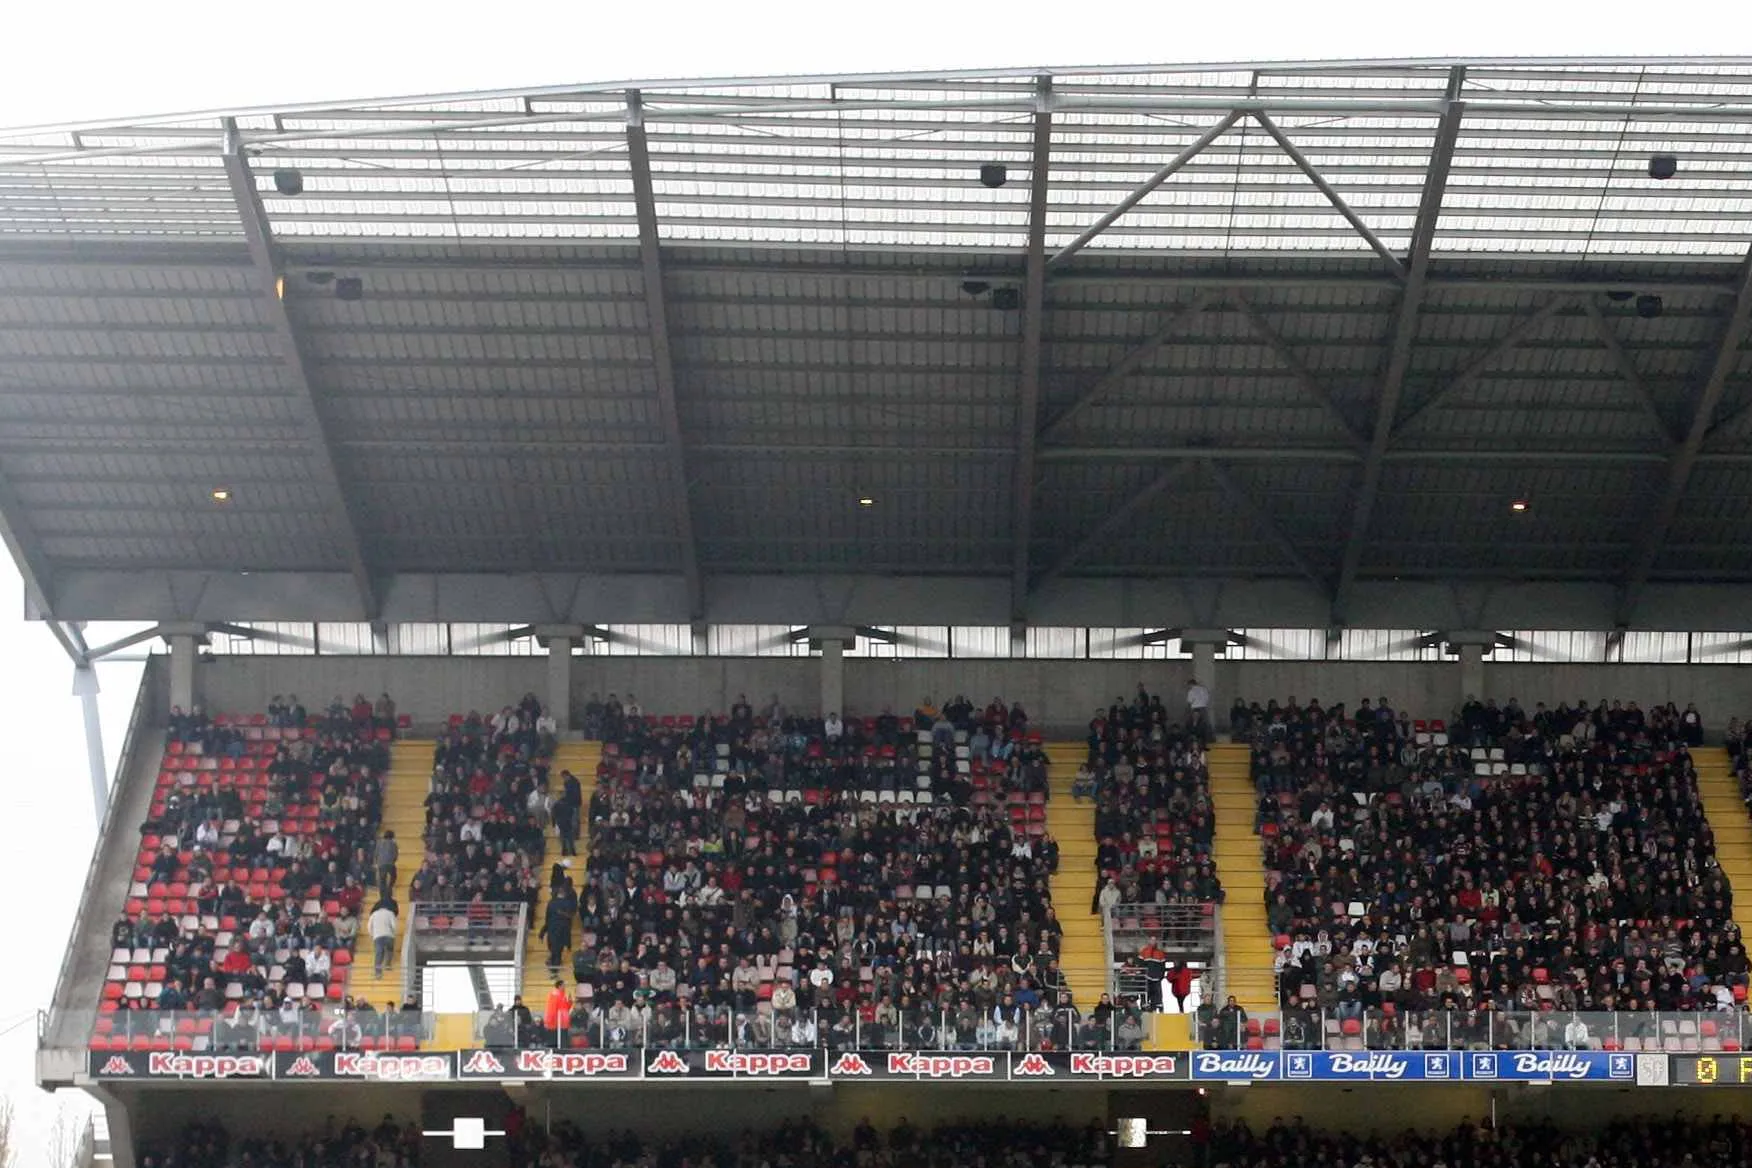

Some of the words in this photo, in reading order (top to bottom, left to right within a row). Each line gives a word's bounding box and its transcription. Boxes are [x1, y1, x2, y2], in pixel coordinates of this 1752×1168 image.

[149, 1052, 257, 1076] Kappa
[520, 1050, 625, 1072] Kappa
[705, 1050, 810, 1073] Kappa
[888, 1051, 993, 1075] Kappa
[1071, 1052, 1175, 1076] Kappa
[1197, 1053, 1274, 1078] Bailly
[1329, 1053, 1408, 1078] Bailly
[1514, 1053, 1591, 1078] Bailly
[1696, 1057, 1717, 1083] 0
